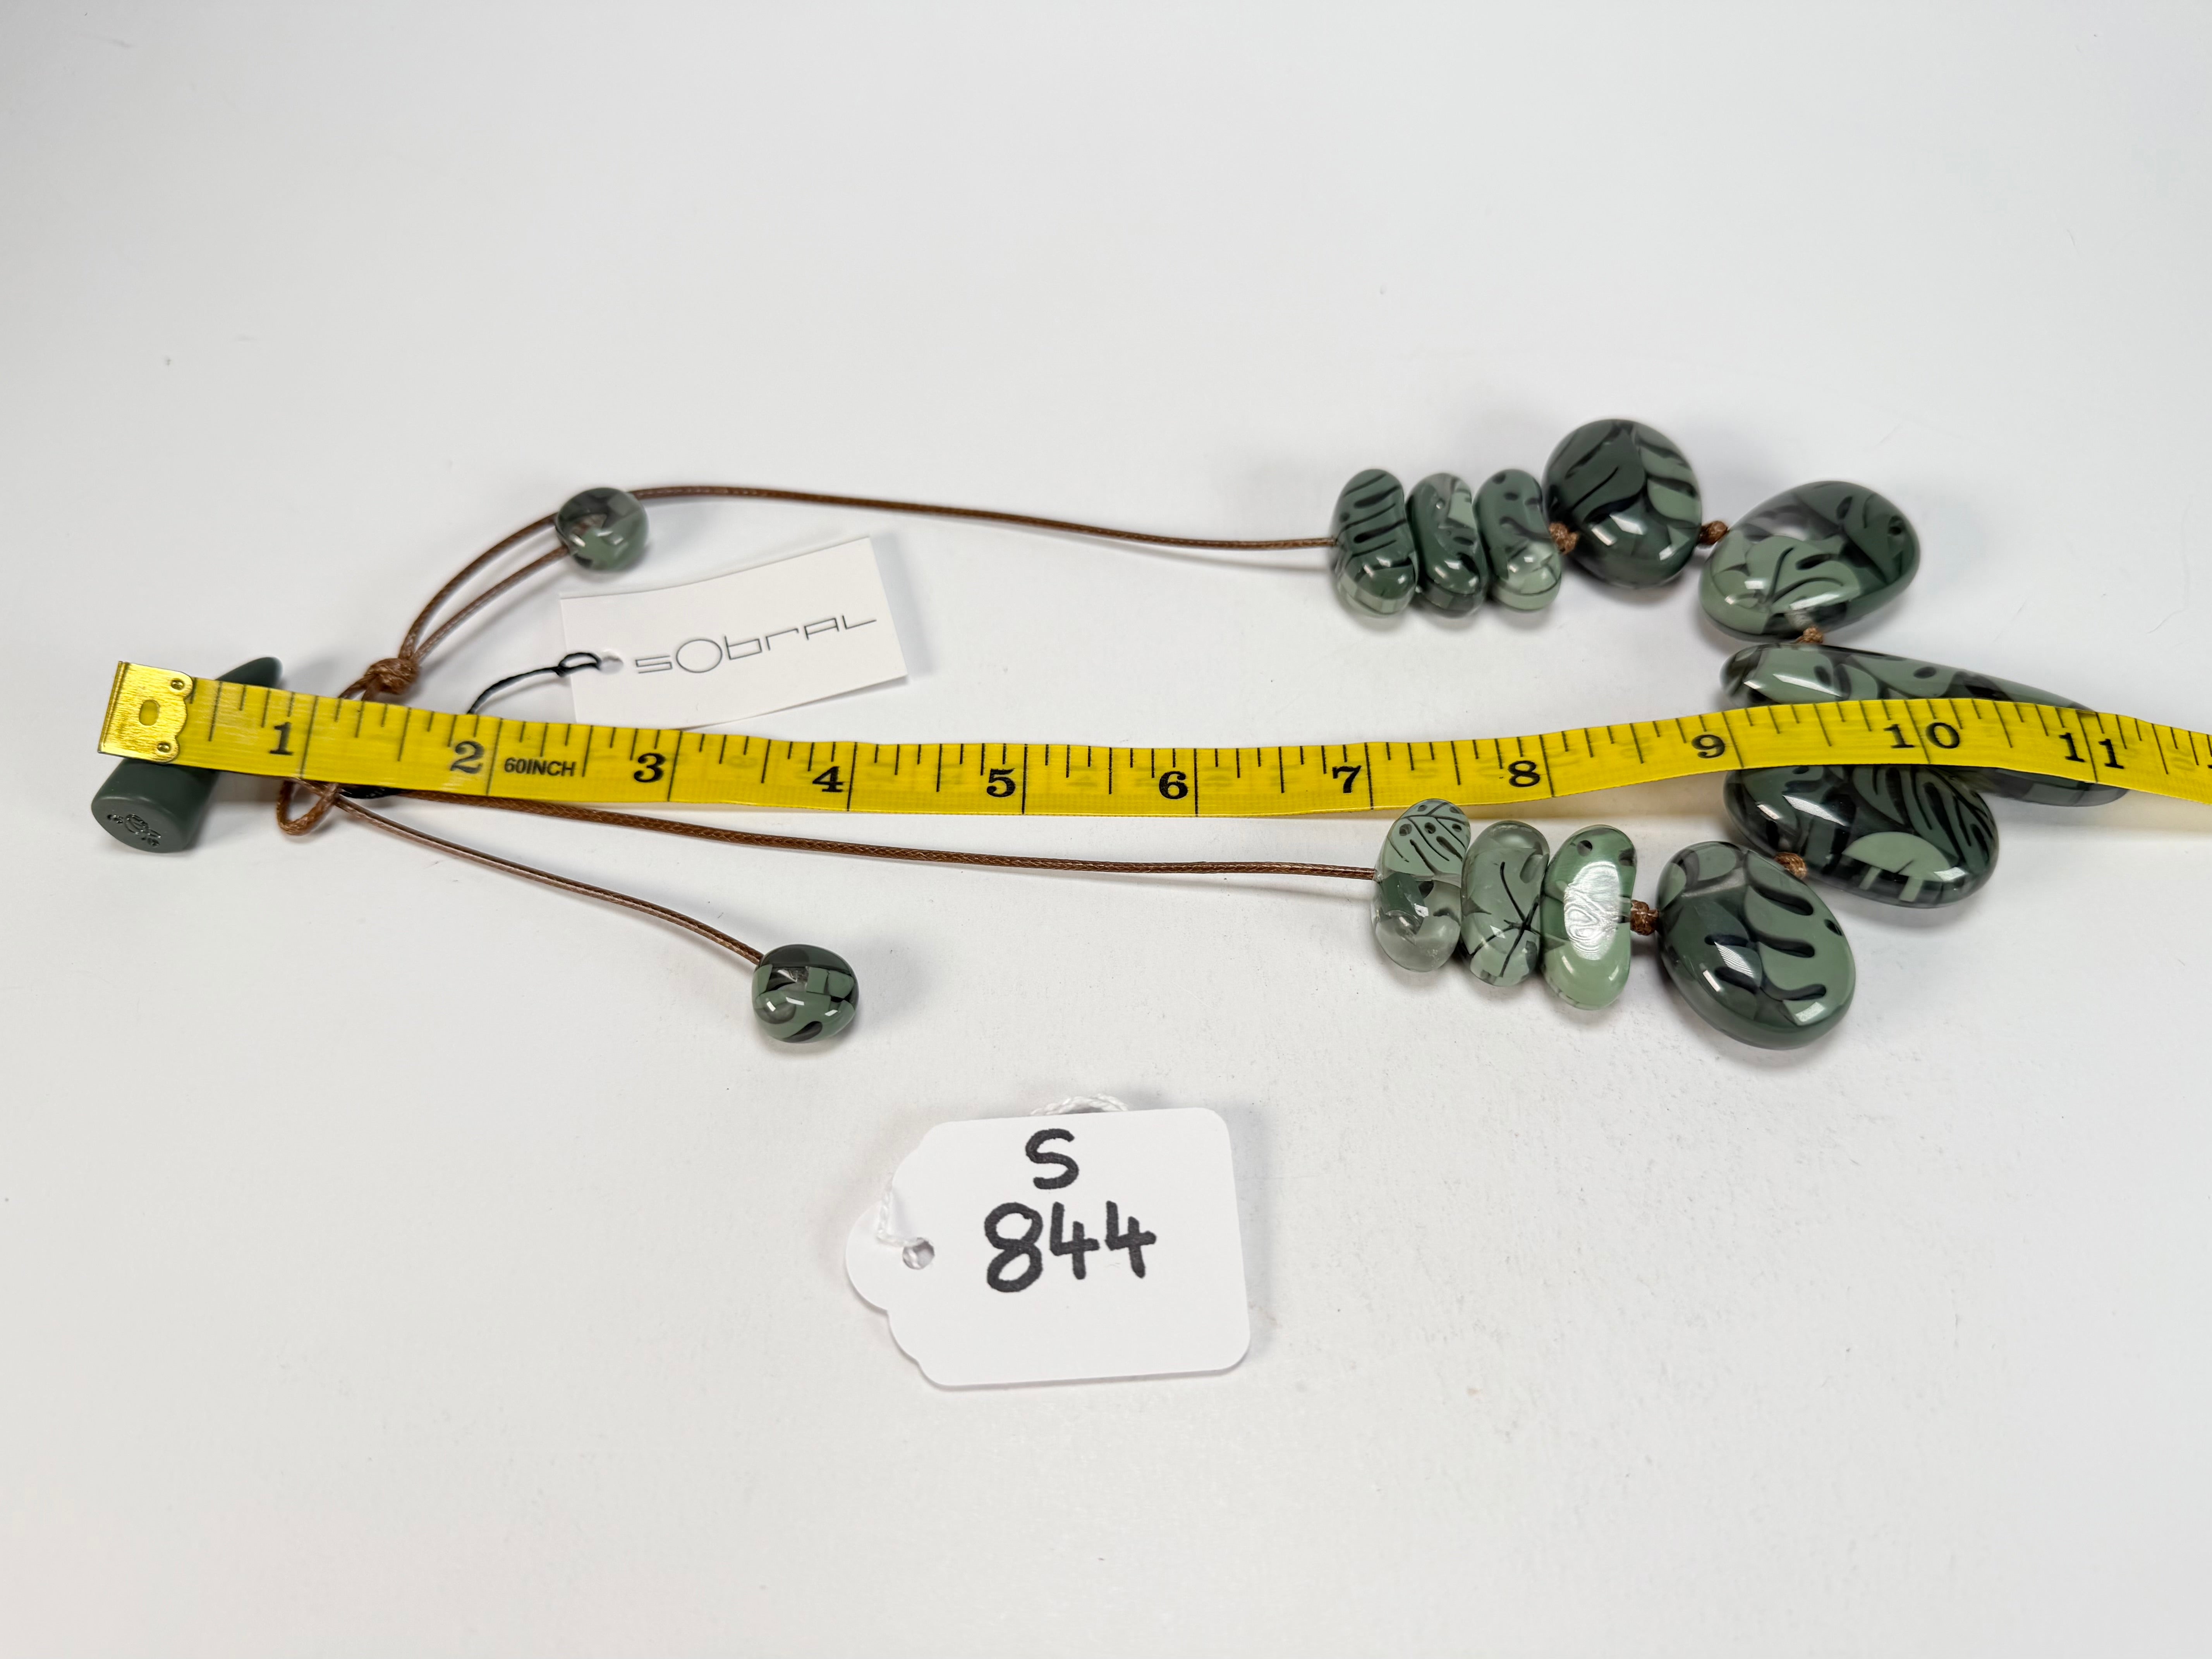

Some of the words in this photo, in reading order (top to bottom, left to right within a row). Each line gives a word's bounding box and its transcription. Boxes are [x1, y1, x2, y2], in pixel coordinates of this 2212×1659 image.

[269, 721, 293, 756] 1
[451, 740, 485, 774] 2
[504, 757, 576, 777] 60INCH
[634, 753, 665, 783] 3
[812, 766, 843, 793] 4
[986, 768, 1016, 797] 5
[1159, 771, 1188, 799] 6
[1332, 765, 1362, 793] 7
[1508, 760, 1540, 787] 8
[1691, 734, 1725, 759] 9
[1883, 722, 1960, 749] 10
[2059, 732, 2124, 769] 11
[1025, 1128, 1079, 1190] S
[984, 1200, 1157, 1292] 844
